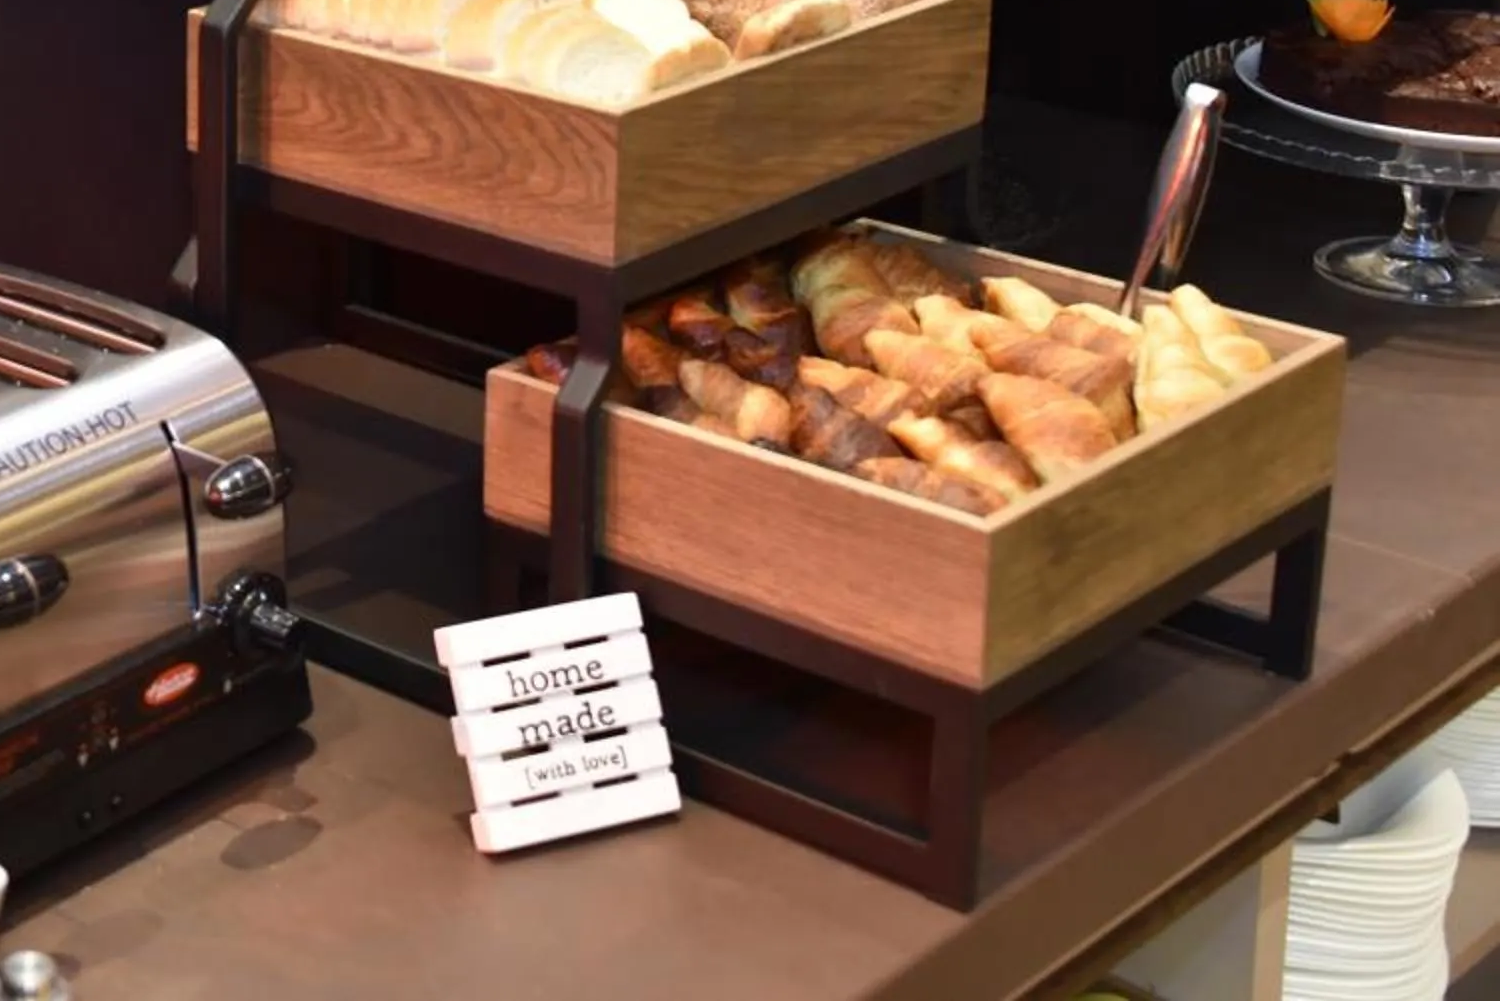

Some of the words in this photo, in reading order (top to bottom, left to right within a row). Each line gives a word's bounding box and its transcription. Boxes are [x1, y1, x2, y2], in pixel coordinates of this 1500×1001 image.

[507, 659, 604, 698] home
[518, 702, 616, 746] made
[524, 760, 576, 789] [with
[582, 745, 629, 772] love]
